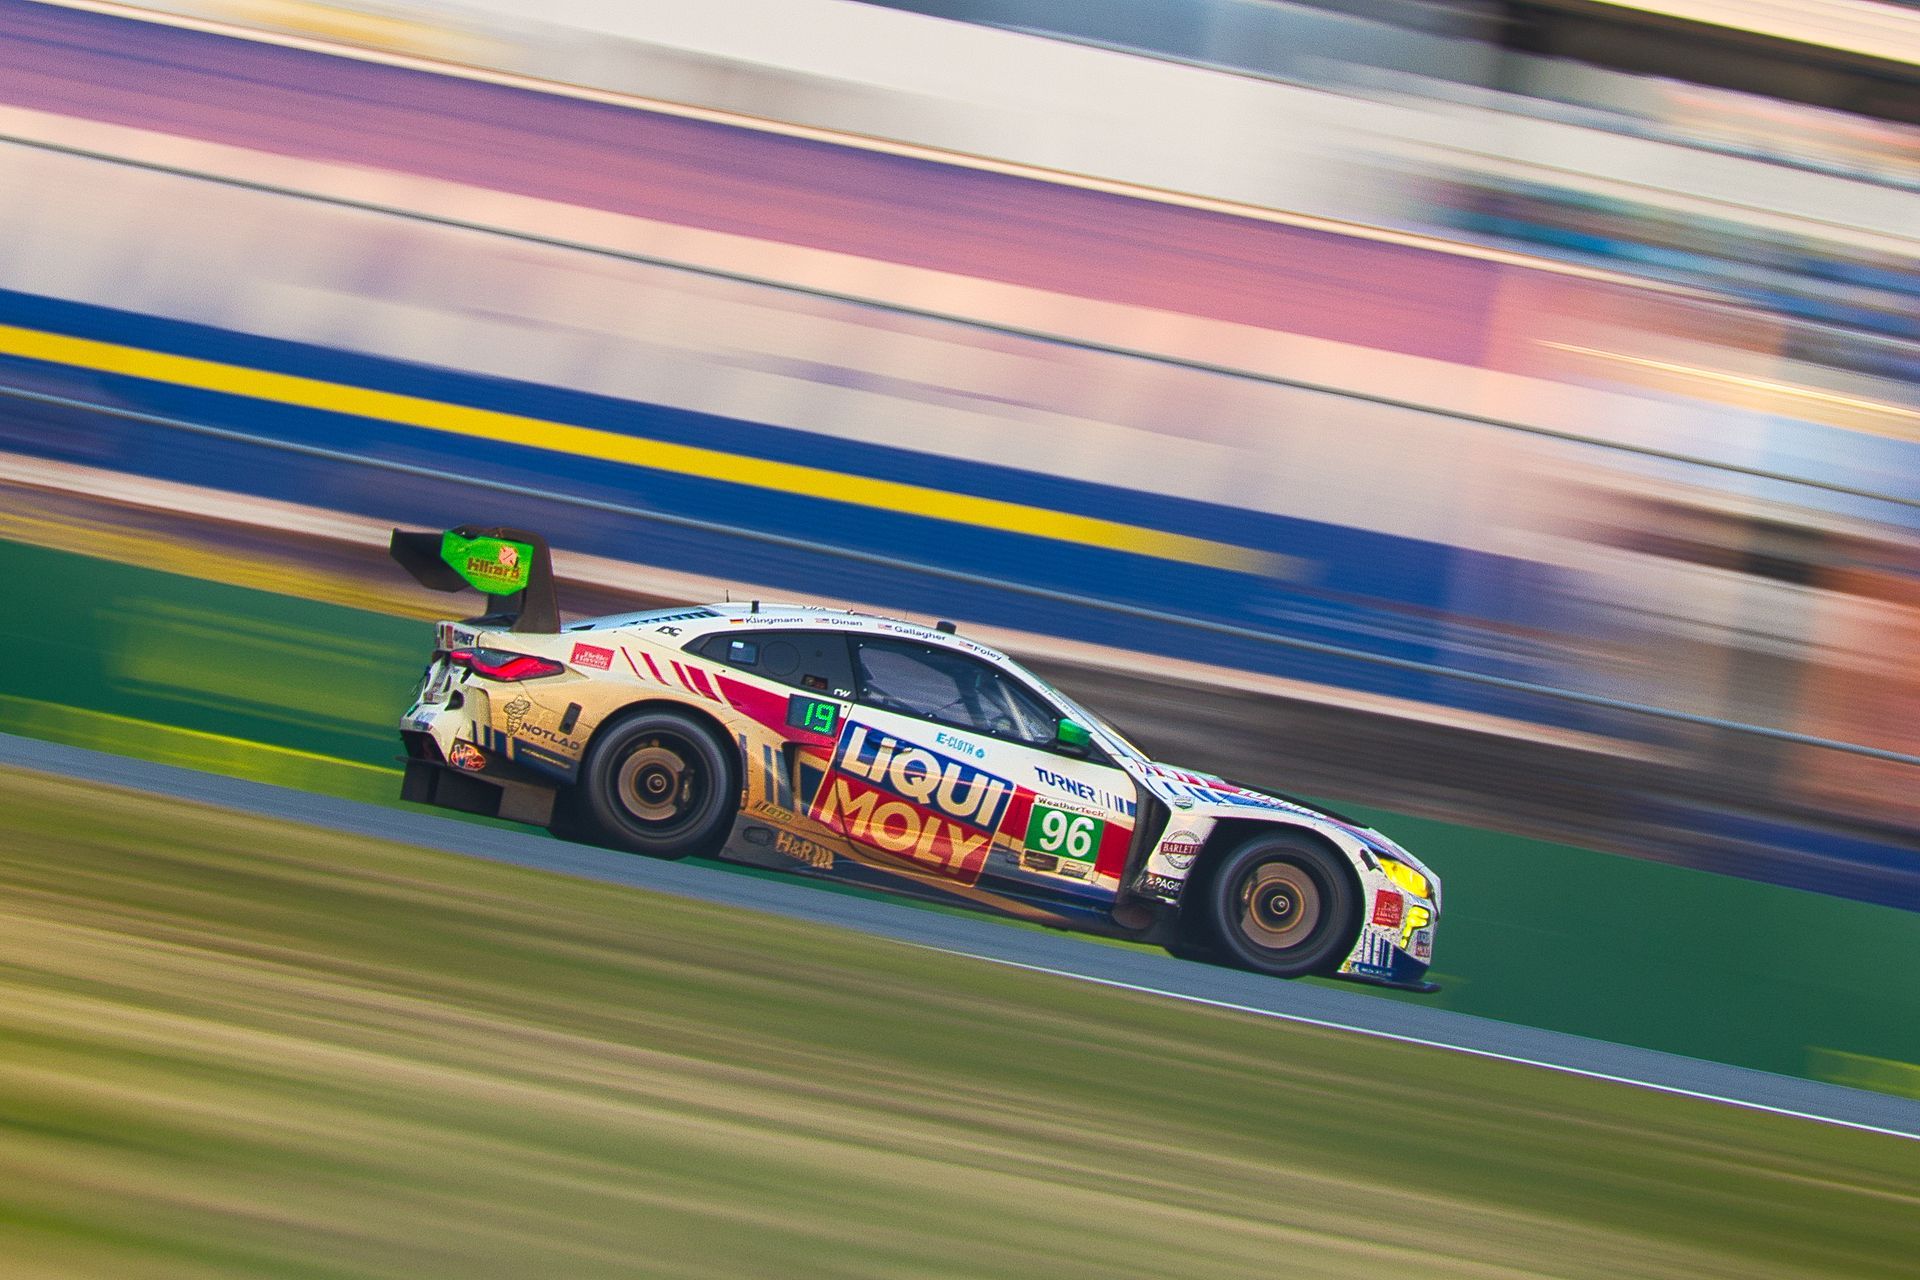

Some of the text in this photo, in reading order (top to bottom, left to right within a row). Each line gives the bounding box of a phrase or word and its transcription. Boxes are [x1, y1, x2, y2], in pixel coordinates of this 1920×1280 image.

[745, 616, 804, 625] Klingmann
[831, 618, 863, 626] Dinan
[894, 626, 947, 641] Gallagher
[973, 645, 1003, 661] Foley
[804, 703, 836, 733] 19
[521, 722, 580, 750] NOTLAD
[840, 726, 1006, 826] LIQUI
[1033, 765, 1097, 803] TURNER
[1038, 796, 1105, 818] WeatherTech
[819, 778, 989, 874] MOLY
[1040, 810, 1095, 858] 96
[775, 829, 812, 861] H&R
